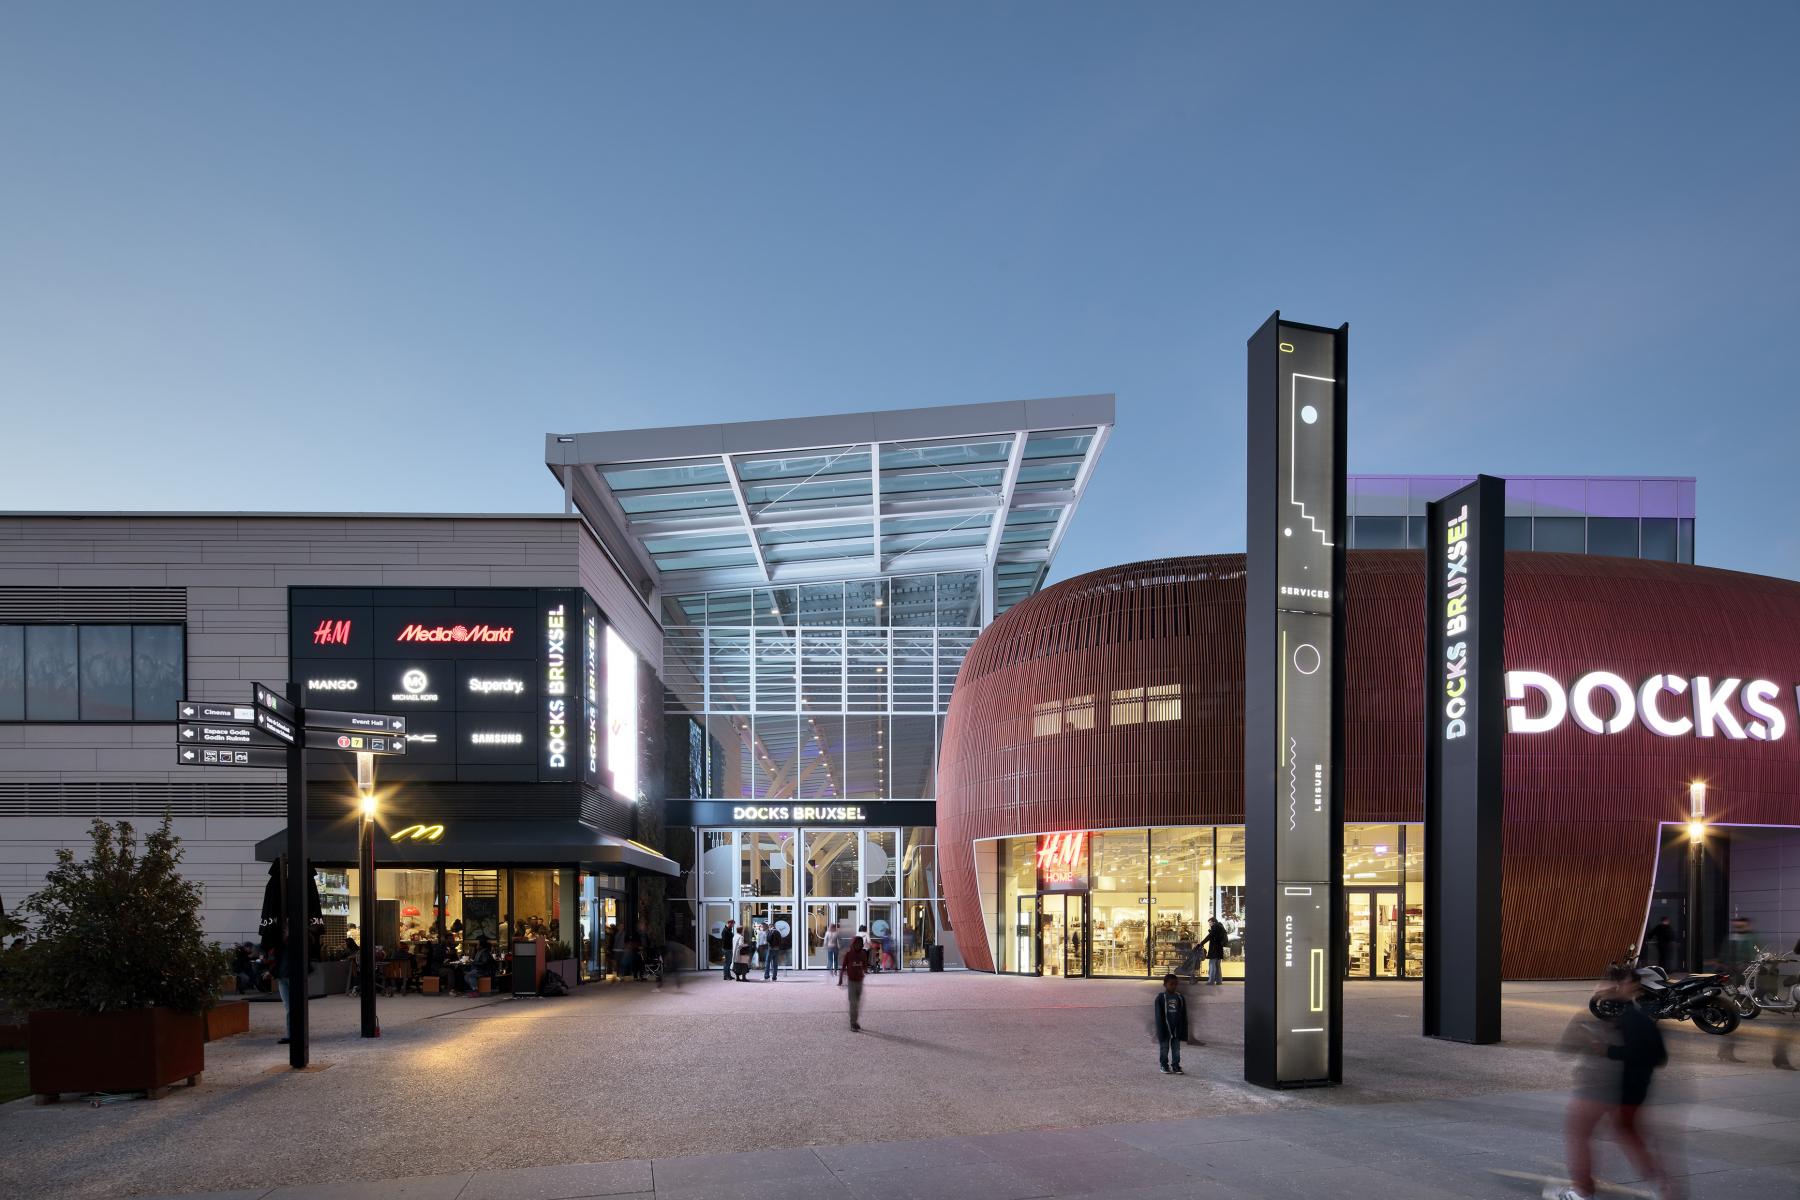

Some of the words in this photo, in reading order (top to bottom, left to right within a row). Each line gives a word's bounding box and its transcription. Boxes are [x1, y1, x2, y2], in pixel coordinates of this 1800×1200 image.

[1281, 586, 1329, 598] SERVICES
[1446, 504, 1468, 637] BRUXSEL
[313, 619, 351, 646] H&M
[548, 604, 564, 694] BRUXSEL
[588, 616, 596, 703] BRUXSEL
[308, 680, 358, 691] MANGO
[1446, 641, 1467, 740] DOCKS
[1504, 670, 1786, 741] DOCKS
[204, 728, 228, 737] Espace
[471, 733, 523, 745] SAMSUNG
[549, 699, 565, 768] DOCKS
[589, 707, 597, 774] DOCKS
[733, 806, 789, 820] DOCKS
[793, 807, 866, 820] BRUXSEL
[1037, 832, 1083, 868] H&M
[1046, 872, 1073, 883] HOME
[1285, 915, 1293, 968] CULTURE
